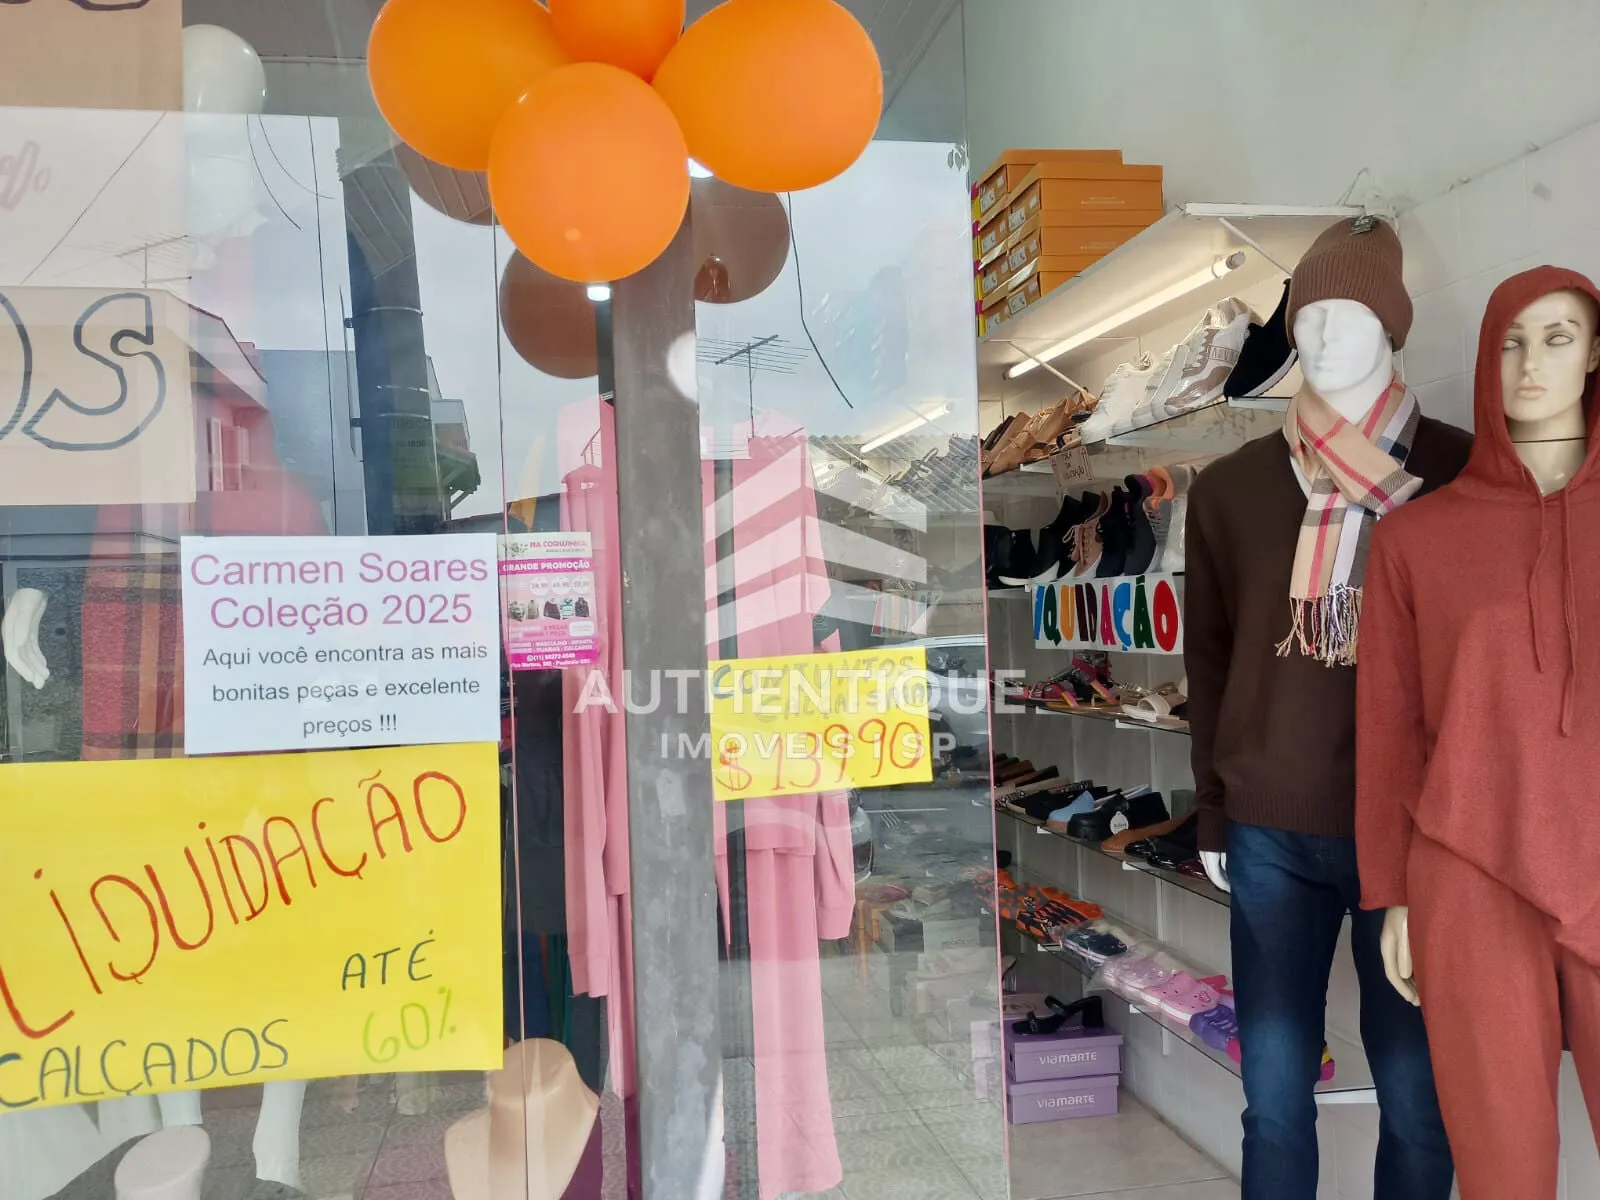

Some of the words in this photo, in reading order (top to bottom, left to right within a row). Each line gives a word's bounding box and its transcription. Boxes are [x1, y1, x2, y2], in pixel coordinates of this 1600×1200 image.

[0, 292, 168, 452] S
[191, 554, 345, 587] Carmen
[359, 552, 489, 585] Soares
[502, 563, 540, 571] GRANDE
[541, 559, 590, 570] PROMOÇÃO
[210, 597, 369, 635] Coleção
[382, 593, 473, 626] 2025
[203, 647, 255, 669] Aqui
[258, 644, 309, 666] você
[315, 644, 404, 664] encontra
[411, 647, 435, 662] as
[440, 640, 488, 660] mais
[212, 682, 290, 702] bonitas
[297, 683, 361, 705] peças
[366, 683, 378, 697] e
[384, 677, 481, 698] excelente
[302, 716, 373, 740] preços
[378, 713, 398, 732] !!!
[0, 769, 468, 1039] LIQUIDAÇÃO
[341, 929, 436, 991] ATÉ
[362, 985, 458, 1065] 60%
[0, 1018, 290, 1109] CALÇADOS
